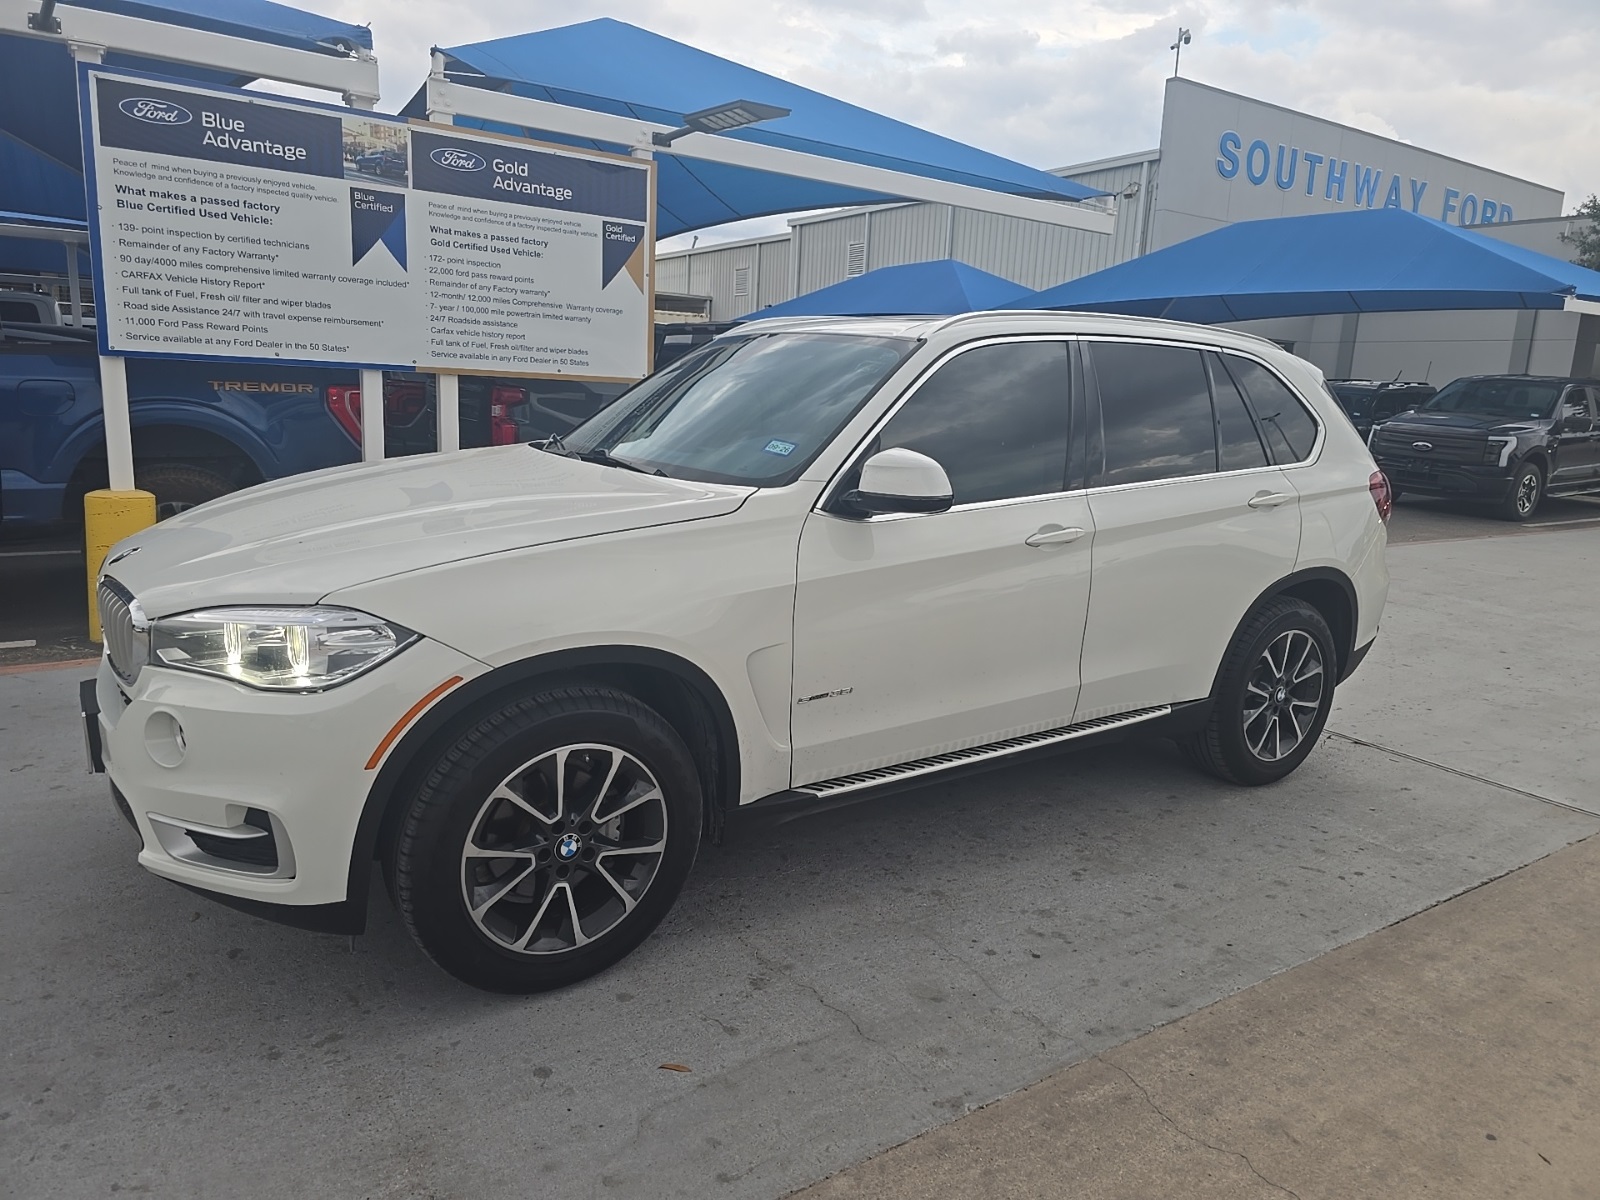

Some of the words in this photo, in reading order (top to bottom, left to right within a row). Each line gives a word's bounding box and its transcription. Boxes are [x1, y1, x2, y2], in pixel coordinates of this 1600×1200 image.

[133, 100, 178, 122] Ford
[202, 112, 245, 132] Blue
[202, 131, 306, 160] Advantage
[441, 150, 476, 168] Ford
[492, 159, 528, 176] Gold
[113, 157, 138, 167] Peace
[193, 168, 218, 179] buying
[226, 174, 261, 184] previously
[262, 179, 290, 187] enjoyed
[1217, 130, 1428, 213] SOUTHWAY
[1442, 187, 1512, 224] FORD
[113, 168, 156, 180] Knowledge
[174, 176, 214, 186] confidence
[230, 182, 254, 193] factory
[256, 186, 289, 196] inspected
[290, 192, 312, 200] quality
[493, 176, 572, 200] Advantage
[115, 184, 146, 196] What
[149, 190, 187, 201] makes
[200, 196, 239, 207] passed
[243, 200, 281, 214] factory
[354, 191, 374, 202] Blue
[117, 198, 143, 210] Blue
[146, 202, 195, 216] Certified
[198, 208, 227, 219] Used
[230, 212, 274, 224] Vehicle:
[354, 200, 393, 213] Certified
[141, 226, 164, 234] point
[166, 228, 212, 239] inspection
[214, 232, 225, 242] by
[227, 235, 261, 244] certified
[263, 238, 310, 249] technicians
[430, 225, 452, 235] What
[454, 230, 481, 238] makes
[490, 234, 519, 243] passed
[521, 236, 549, 248] factory
[606, 224, 623, 233] Gold
[606, 232, 635, 242] Certified
[118, 238, 169, 250] Remainder
[183, 246, 200, 255] any
[202, 246, 235, 258] Factory
[430, 238, 450, 247] Gold
[452, 240, 488, 251] Certified
[490, 245, 510, 254] Used
[512, 247, 544, 258] Vehicle:
[120, 254, 132, 262] 90
[134, 256, 177, 266] day/4000
[179, 260, 203, 269] miles
[205, 264, 270, 275] comprehensive
[272, 268, 299, 278] limited
[301, 273, 336, 282] warranty
[338, 276, 374, 285] coverage
[455, 268, 469, 277] ford
[466, 259, 502, 268] inspection
[121, 270, 162, 280] CARFAX
[164, 273, 198, 283] Vehicle
[200, 277, 231, 288] History
[430, 278, 468, 288] Remainder
[493, 284, 518, 295] Factory
[122, 285, 139, 293] Full
[200, 291, 225, 300] Fresh
[242, 295, 261, 303] filter
[280, 299, 302, 307] wiper
[304, 300, 332, 309] blades
[512, 298, 563, 308] Comprehensive
[565, 303, 594, 313] Warranty
[123, 301, 148, 310] Road
[151, 303, 170, 312] side
[171, 304, 220, 315] Assistance
[222, 308, 240, 316] 24/7
[158, 318, 179, 327] Ford
[181, 320, 204, 329] Pass
[206, 322, 239, 331] Reward
[242, 324, 269, 333] Points
[447, 316, 481, 325] Roadside
[125, 332, 160, 341] Service
[216, 338, 231, 347] any
[233, 338, 253, 346] Ford
[255, 339, 283, 348] Dealer
[430, 326, 454, 334] Carfax
[481, 330, 504, 339] history
[208, 381, 313, 393] TREMOR
